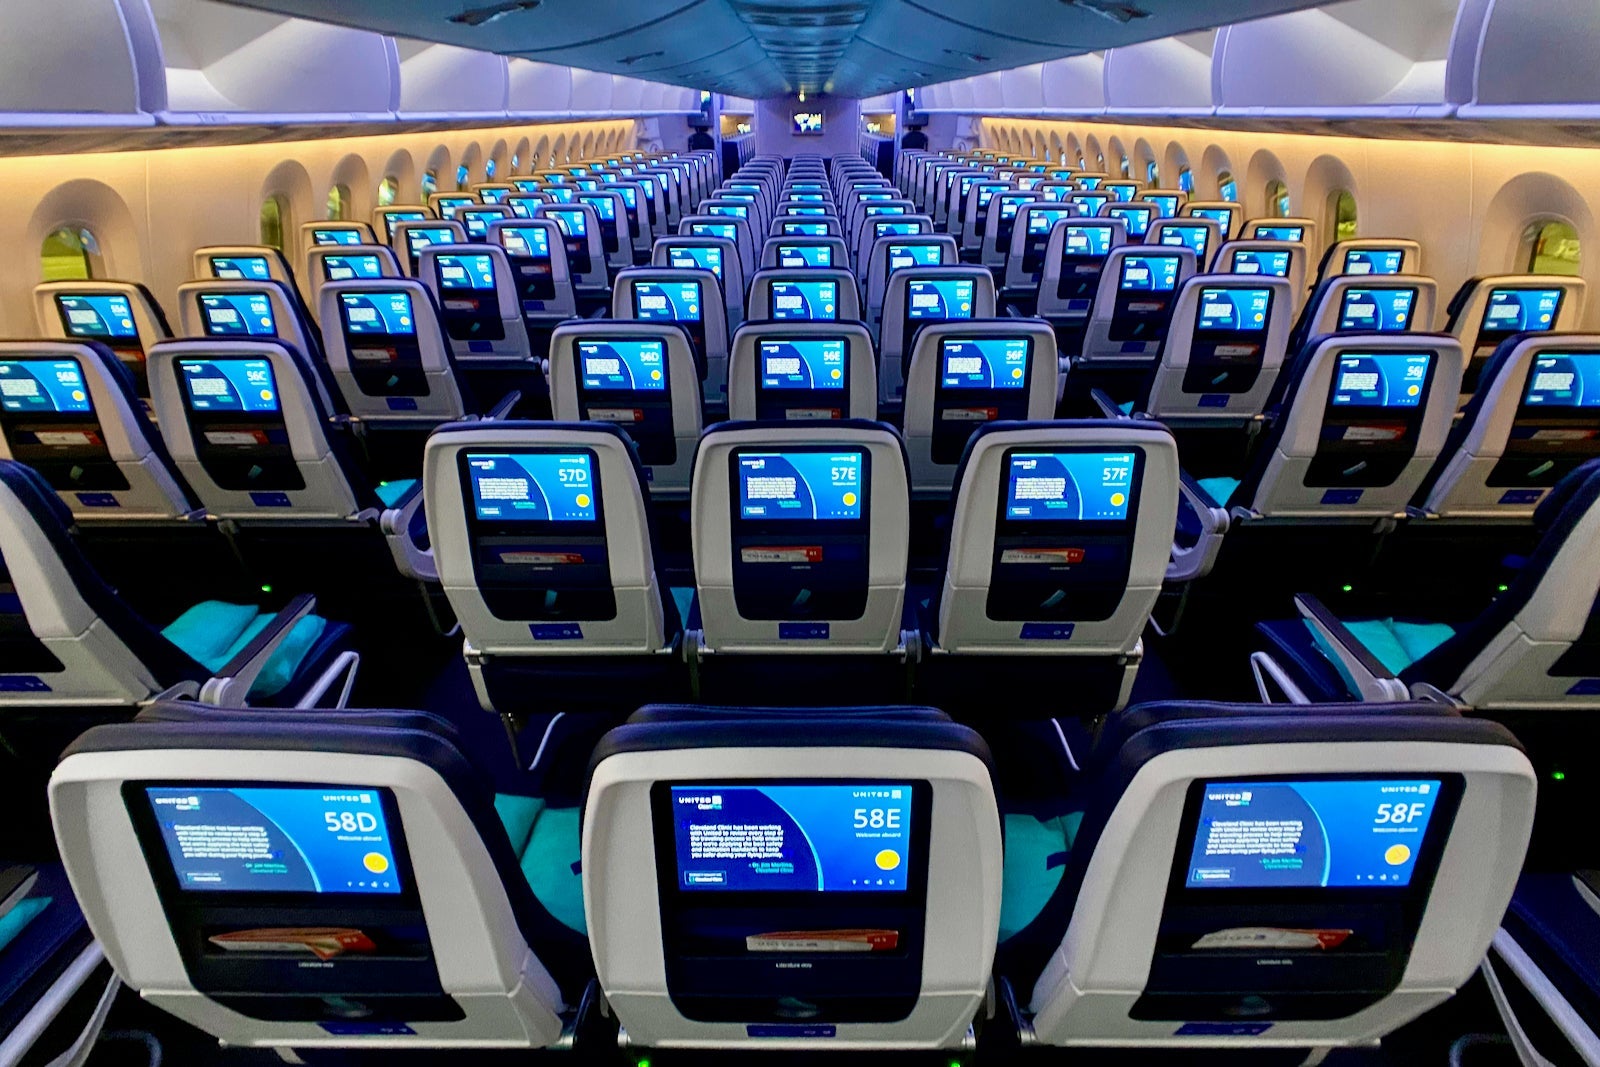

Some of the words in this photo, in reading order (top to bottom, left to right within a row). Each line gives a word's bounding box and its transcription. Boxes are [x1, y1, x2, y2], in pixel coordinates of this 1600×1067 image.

[640, 352, 660, 362] 56D
[824, 351, 840, 361] 56E
[1006, 350, 1024, 360] 56F
[559, 468, 586, 482] 57D
[832, 467, 856, 480] 57E
[1102, 468, 1128, 480] 57F
[854, 808, 901, 828] 58E
[1374, 803, 1425, 823] 58F
[324, 812, 377, 832] 58D
